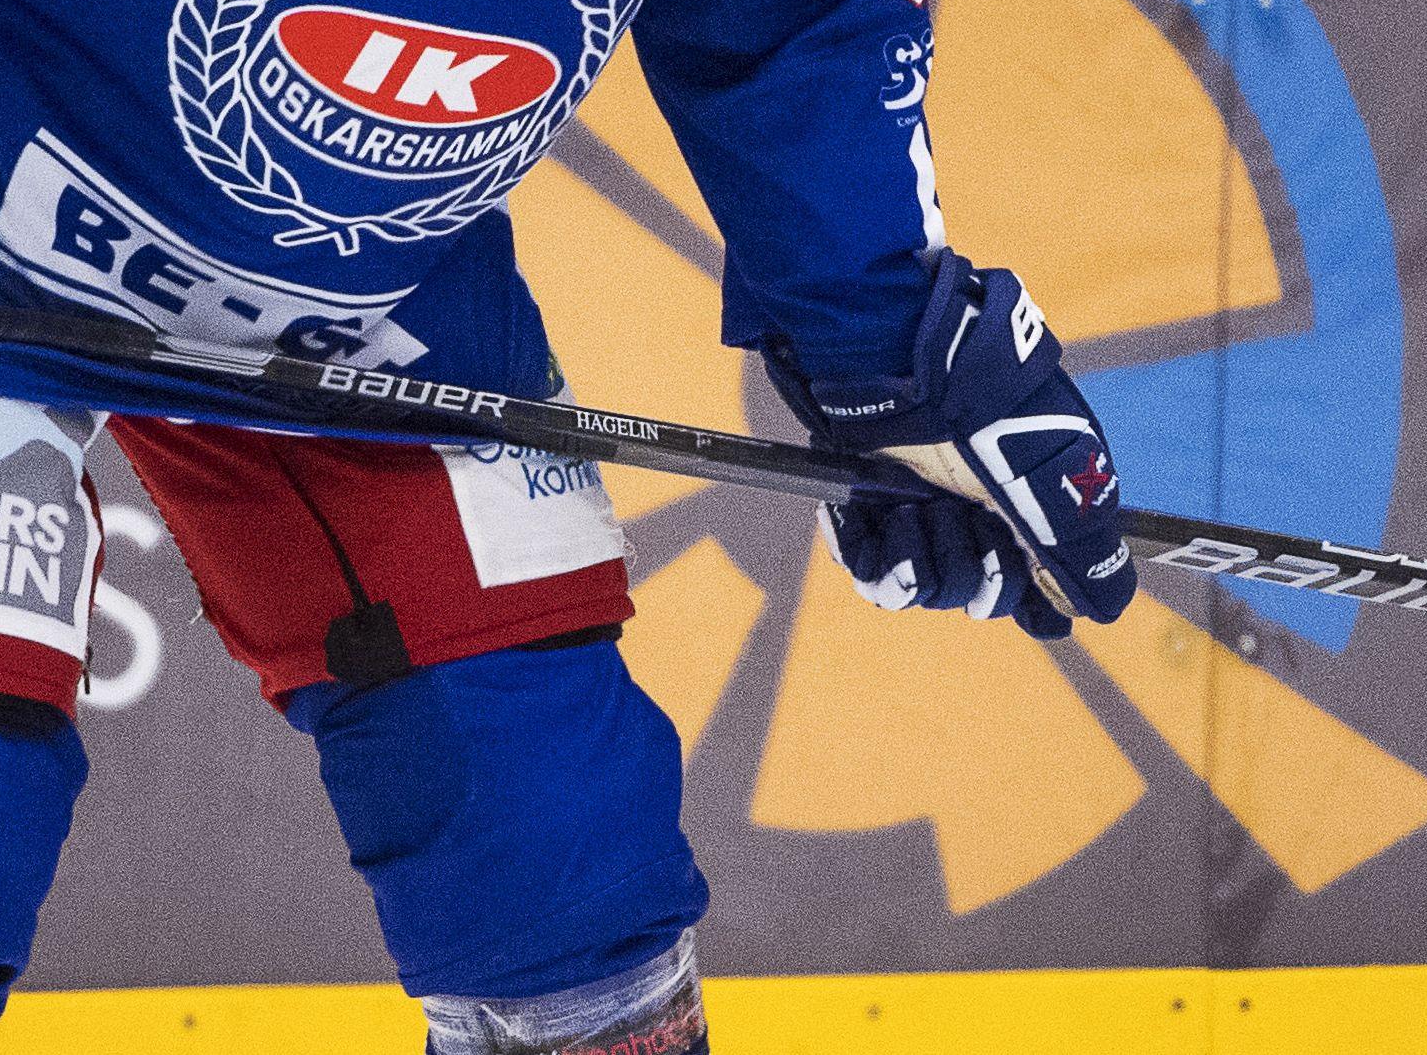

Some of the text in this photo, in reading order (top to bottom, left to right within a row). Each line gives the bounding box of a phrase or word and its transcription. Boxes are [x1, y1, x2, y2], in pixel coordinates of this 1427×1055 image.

[258, 57, 531, 168] OSKARSHAMN
[342, 30, 510, 113] IK
[52, 183, 385, 367] BE-G
[318, 363, 507, 418] BAUER
[576, 410, 660, 441] HAGELIN
